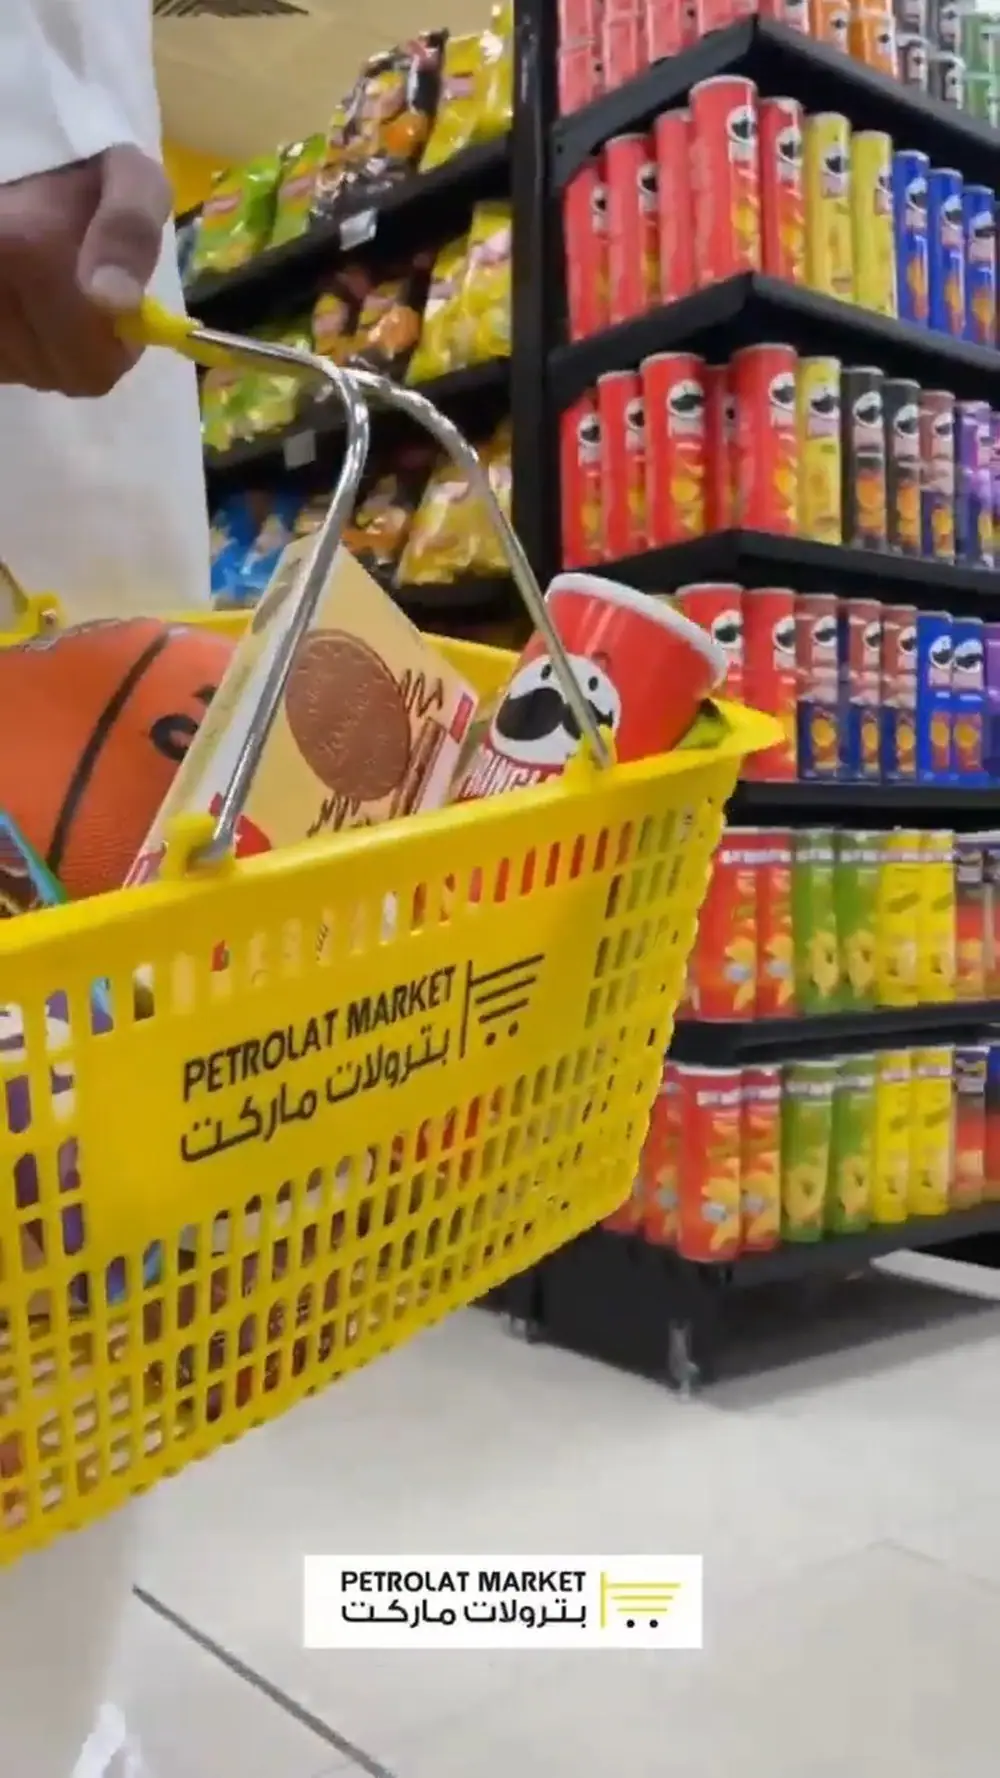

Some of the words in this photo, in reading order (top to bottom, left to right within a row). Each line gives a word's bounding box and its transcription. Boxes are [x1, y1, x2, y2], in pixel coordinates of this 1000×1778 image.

[183, 1008, 338, 1103] PETROLAT
[347, 965, 456, 1039] MARKET
[325, 1024, 450, 1103] بترولات
[180, 1083, 317, 1163] ماركت
